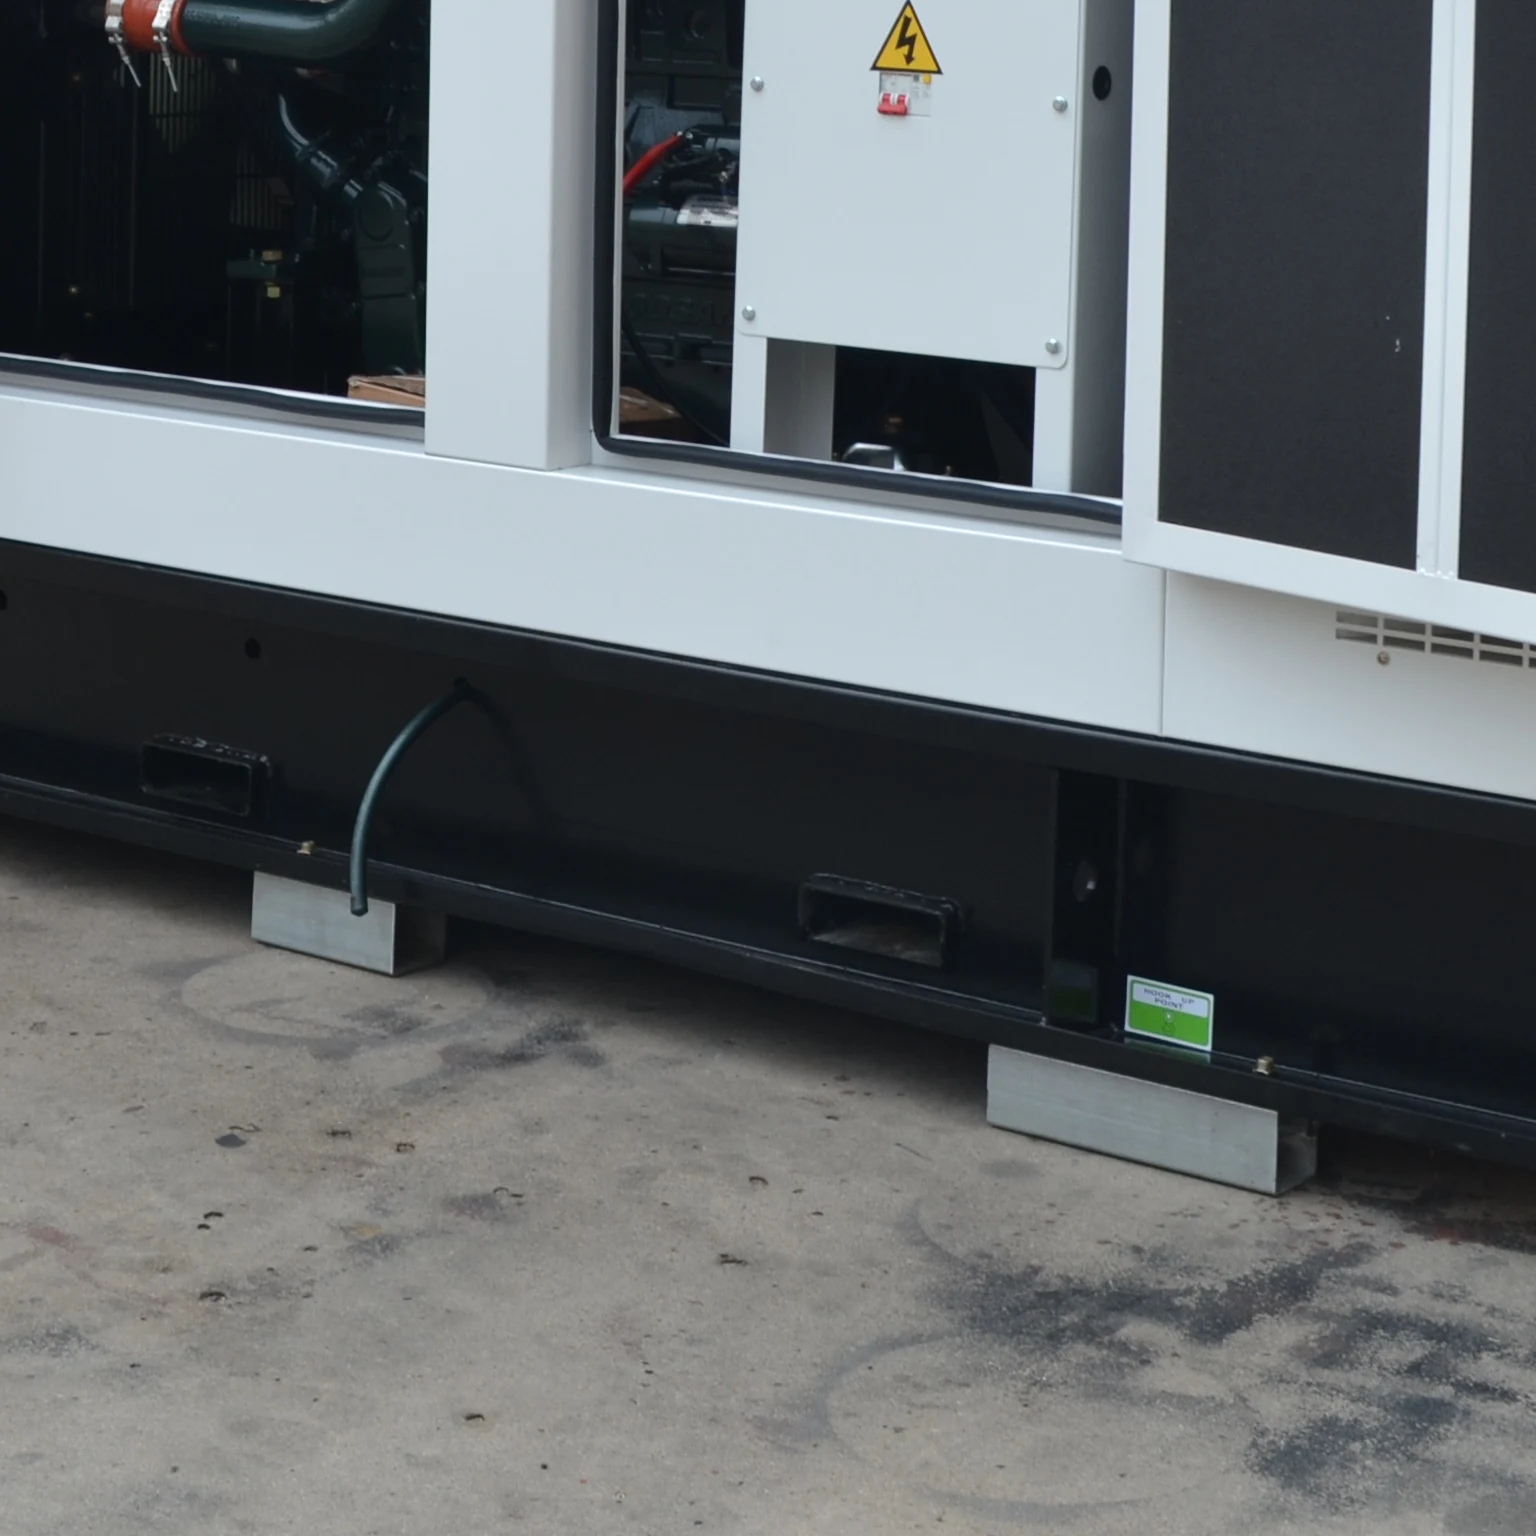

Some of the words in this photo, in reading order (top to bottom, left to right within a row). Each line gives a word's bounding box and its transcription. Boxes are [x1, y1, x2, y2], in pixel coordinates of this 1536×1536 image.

[1144, 988, 1171, 999] HOOK
[1181, 997, 1195, 1005] UP
[1154, 997, 1183, 1009] POINT
